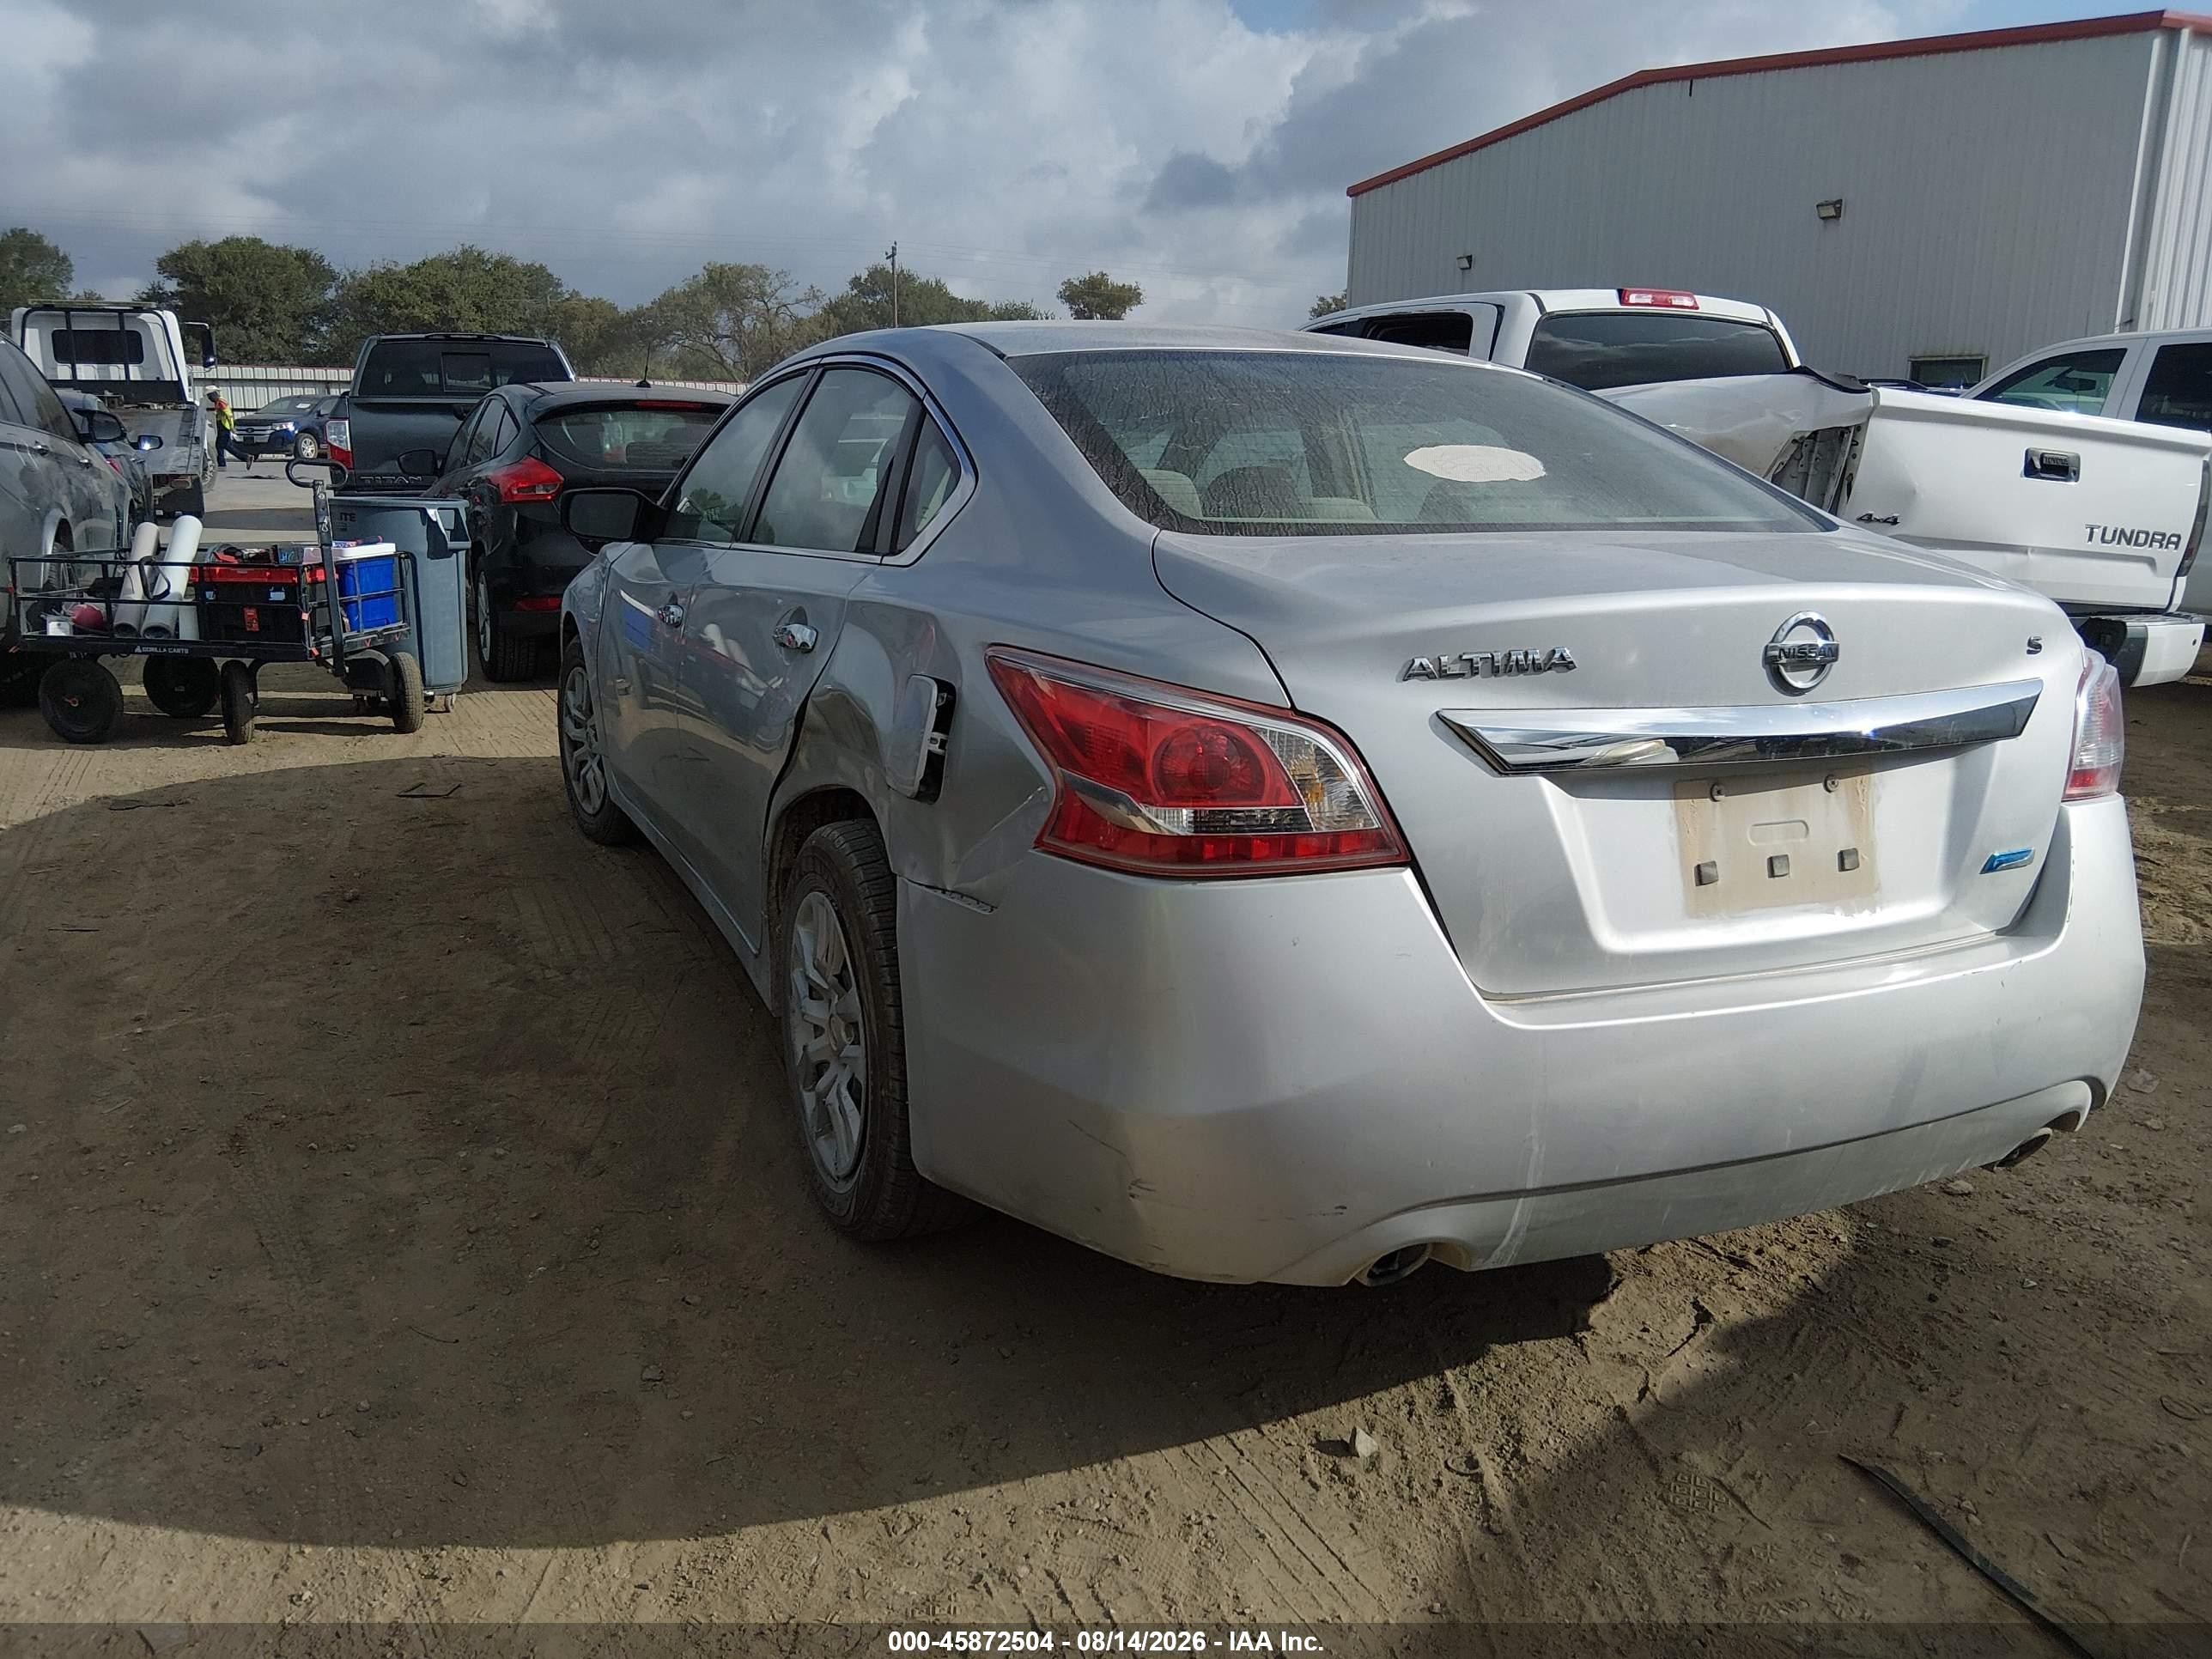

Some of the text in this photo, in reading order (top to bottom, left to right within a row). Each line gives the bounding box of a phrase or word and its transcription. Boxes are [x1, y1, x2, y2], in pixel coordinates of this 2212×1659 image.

[360, 476, 422, 485] TITAN
[1856, 512, 1900, 526] 4x4
[2085, 524, 2182, 550] TUNDRA
[1778, 646, 1834, 659] NISSAN
[2026, 635, 2043, 655] S
[1400, 647, 1577, 683] ALTIMA
